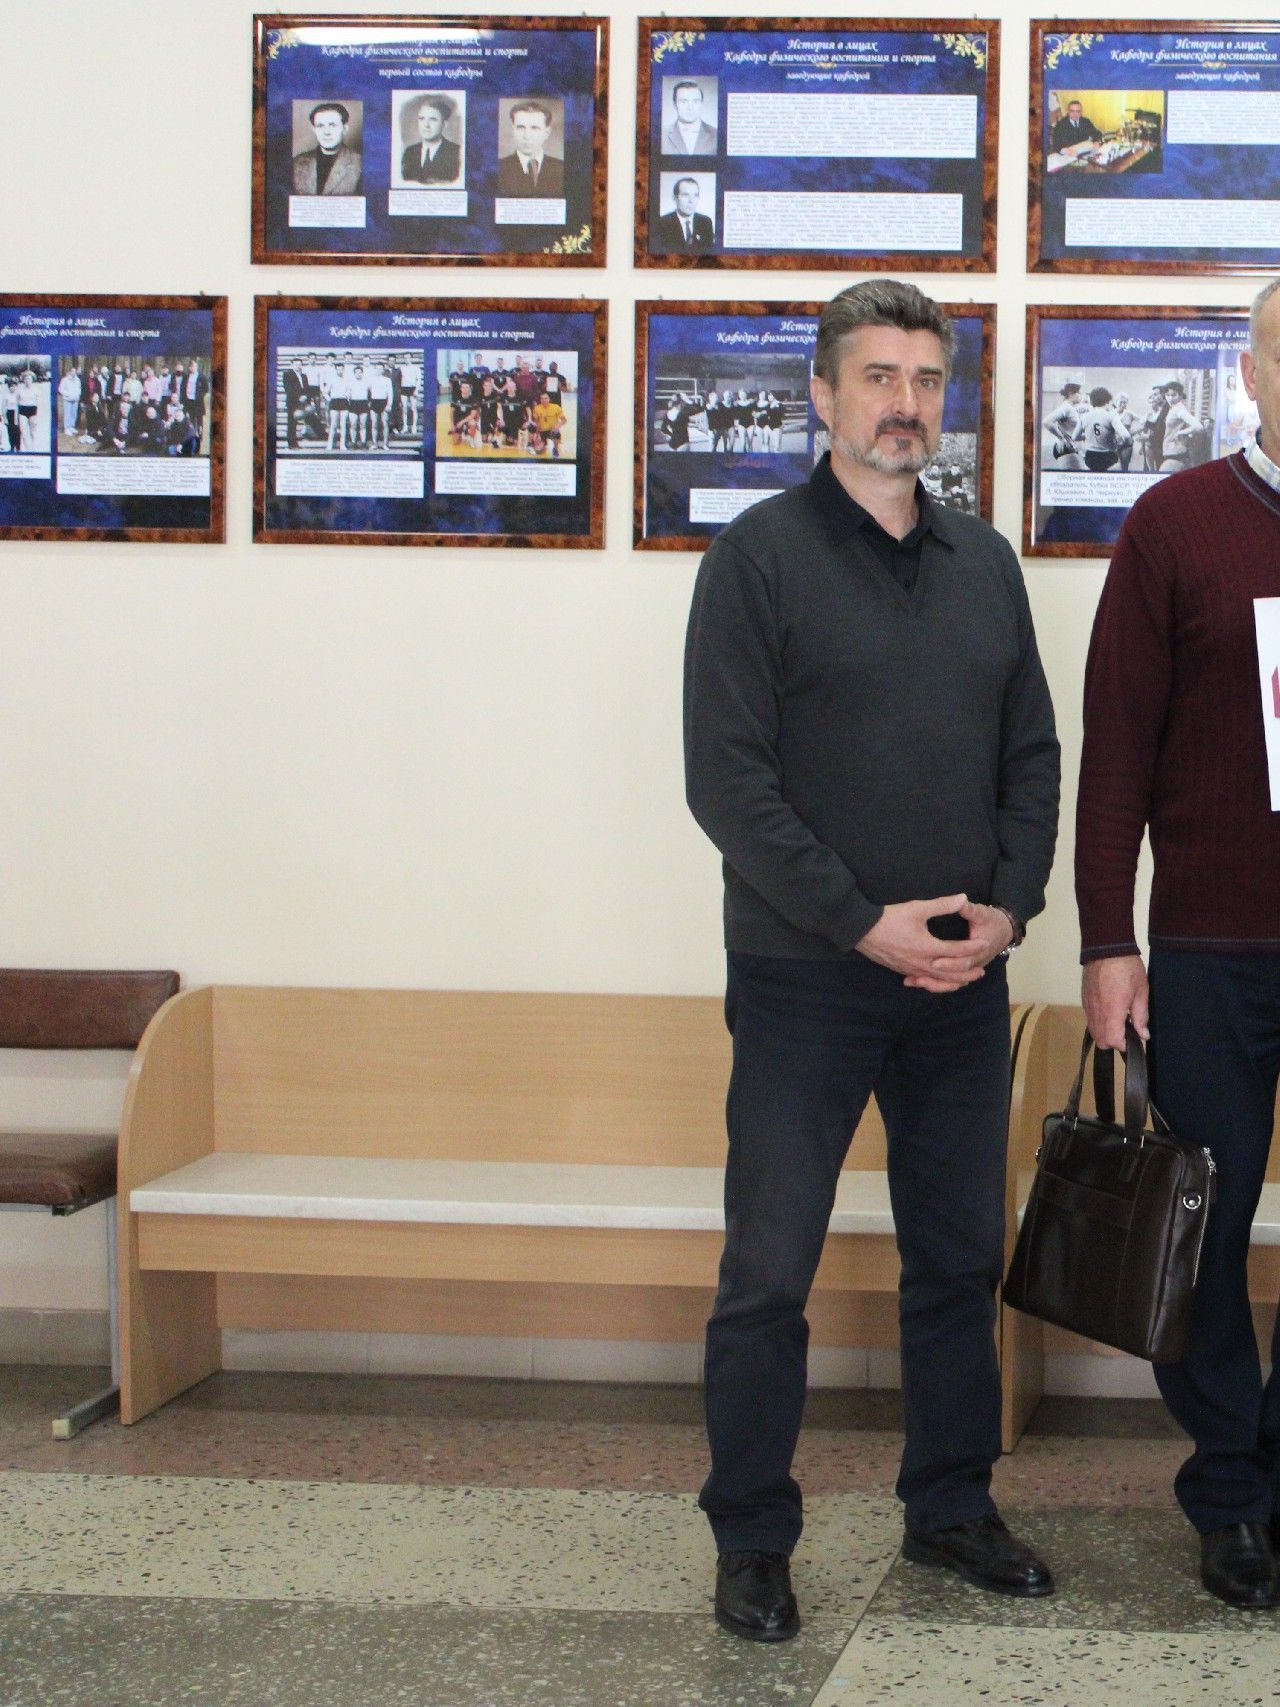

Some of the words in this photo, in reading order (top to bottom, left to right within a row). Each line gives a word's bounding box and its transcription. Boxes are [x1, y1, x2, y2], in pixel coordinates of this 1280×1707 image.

[321, 44, 363, 58] Кафедра
[364, 44, 424, 58] физического
[425, 46, 482, 56] воспитания
[493, 48, 528, 59] спорта
[787, 39, 835, 52] История
[837, 42, 843, 50] в
[845, 41, 878, 52] лицах
[1175, 38, 1224, 51] История
[1226, 41, 1232, 50] в
[1234, 41, 1267, 52] лицах
[724, 51, 767, 64] Кафедра
[768, 51, 829, 64] физического
[831, 54, 890, 63] воспитания
[892, 55, 898, 63] и
[900, 54, 936, 65] спорта
[1110, 49, 1154, 64] Кафедра
[1155, 49, 1217, 64] физического
[1217, 52, 1278, 61] воспитания
[19, 314, 65, 328] История
[67, 318, 72, 326] в
[75, 318, 107, 328] лицах
[392, 315, 440, 328] История
[441, 317, 447, 326] в
[449, 317, 481, 328] лицах
[60, 327, 116, 337] воспитания
[118, 329, 124, 337] и
[125, 330, 160, 340] спорта
[329, 326, 371, 339] Кафедра
[372, 326, 431, 340] физического
[432, 329, 490, 339] воспитания
[492, 330, 498, 338] и
[499, 330, 535, 341] спорта
[717, 331, 760, 345] Кафедра
[1174, 326, 1223, 340] История
[1225, 329, 1231, 338] в
[1110, 338, 1153, 352] Кафедра
[1155, 338, 1216, 352] физического
[1093, 423, 1100, 436] 6
